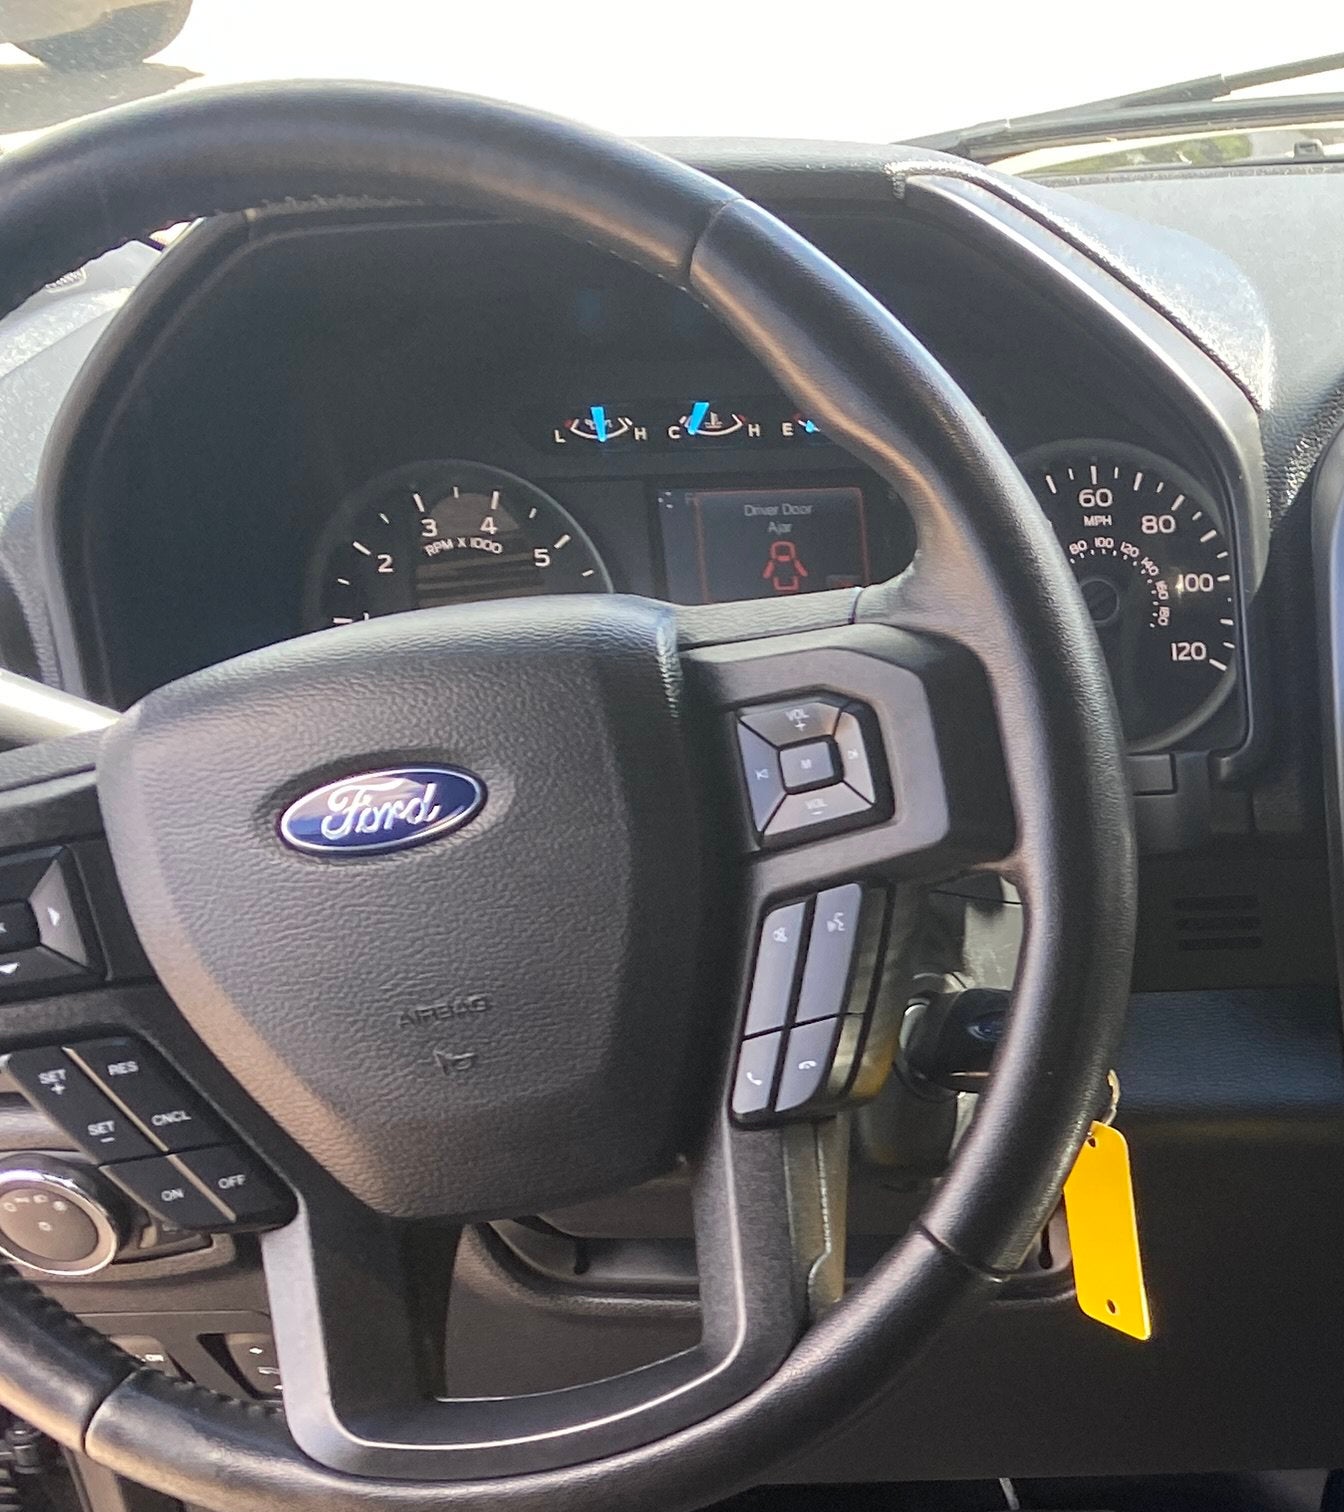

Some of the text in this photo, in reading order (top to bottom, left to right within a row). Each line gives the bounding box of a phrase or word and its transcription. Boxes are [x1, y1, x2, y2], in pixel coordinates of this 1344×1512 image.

[554, 430, 566, 443] L
[634, 428, 647, 440] H
[668, 426, 680, 438] C
[749, 424, 760, 437] H
[782, 423, 793, 436] E
[1078, 488, 1113, 508] 60
[744, 503, 813, 516] Driver Door
[421, 518, 438, 537] 3
[480, 516, 498, 534] 4
[767, 522, 792, 535] Ajar
[1083, 515, 1112, 526] MPH
[1141, 515, 1176, 534] 80
[424, 539, 454, 557] RPM
[470, 538, 502, 554] 1000
[1094, 537, 1114, 550] 100
[1120, 542, 1140, 558] 120
[377, 554, 394, 573] 2
[534, 549, 550, 567] 5
[1140, 557, 1160, 576] 140
[1154, 580, 1170, 600] 160
[1177, 574, 1214, 592] 100
[1171, 642, 1207, 662] 120
[785, 708, 810, 721] VOL
[321, 777, 442, 840] Ford
[38, 1068, 66, 1084] SET
[107, 1061, 139, 1076] RES
[152, 1110, 192, 1126] CNCL
[88, 1120, 116, 1136] SET
[218, 1174, 246, 1189] OFF
[161, 1188, 184, 1202] ON
